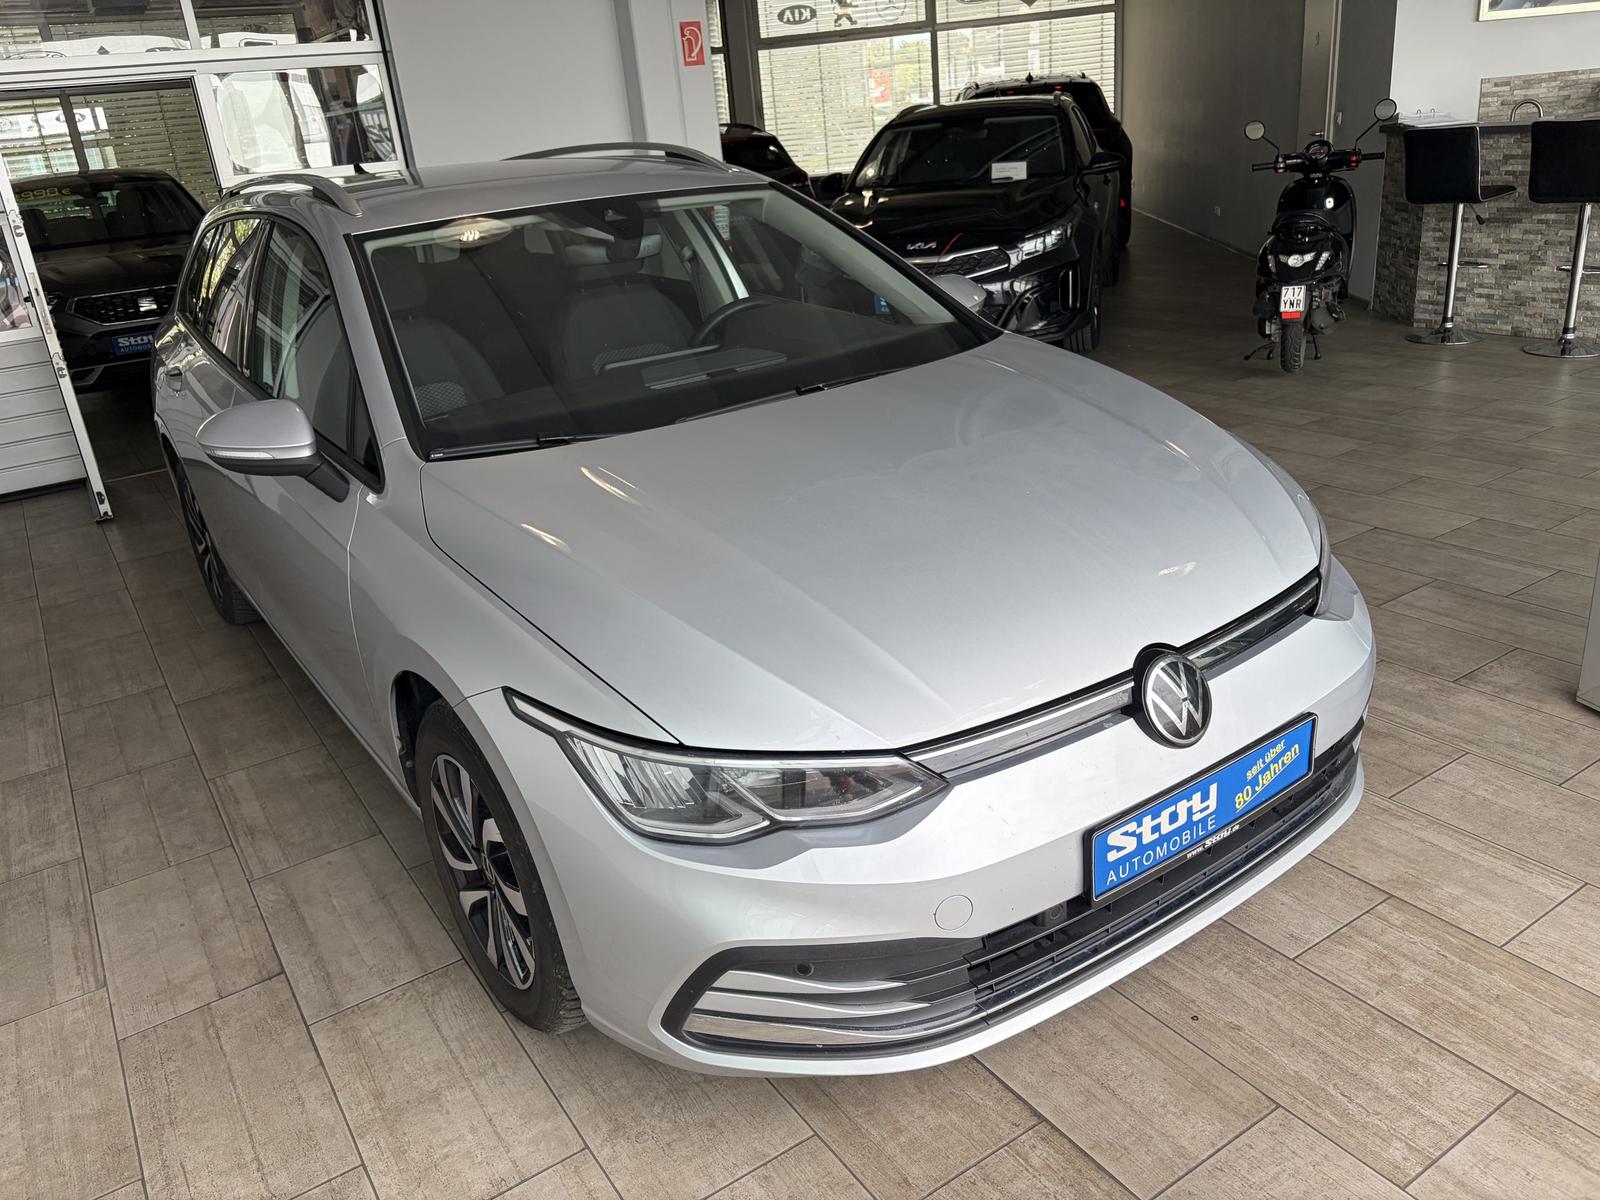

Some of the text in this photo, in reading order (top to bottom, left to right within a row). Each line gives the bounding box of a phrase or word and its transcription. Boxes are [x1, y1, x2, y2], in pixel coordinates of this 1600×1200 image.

[1283, 287, 1303, 298] 717
[1283, 299, 1302, 309] YNR
[1235, 743, 1299, 809] 80 Jahren
[1246, 739, 1286, 779] seit über
[1106, 782, 1218, 863] Stoy
[1106, 814, 1217, 886] AUTOMOBILE
